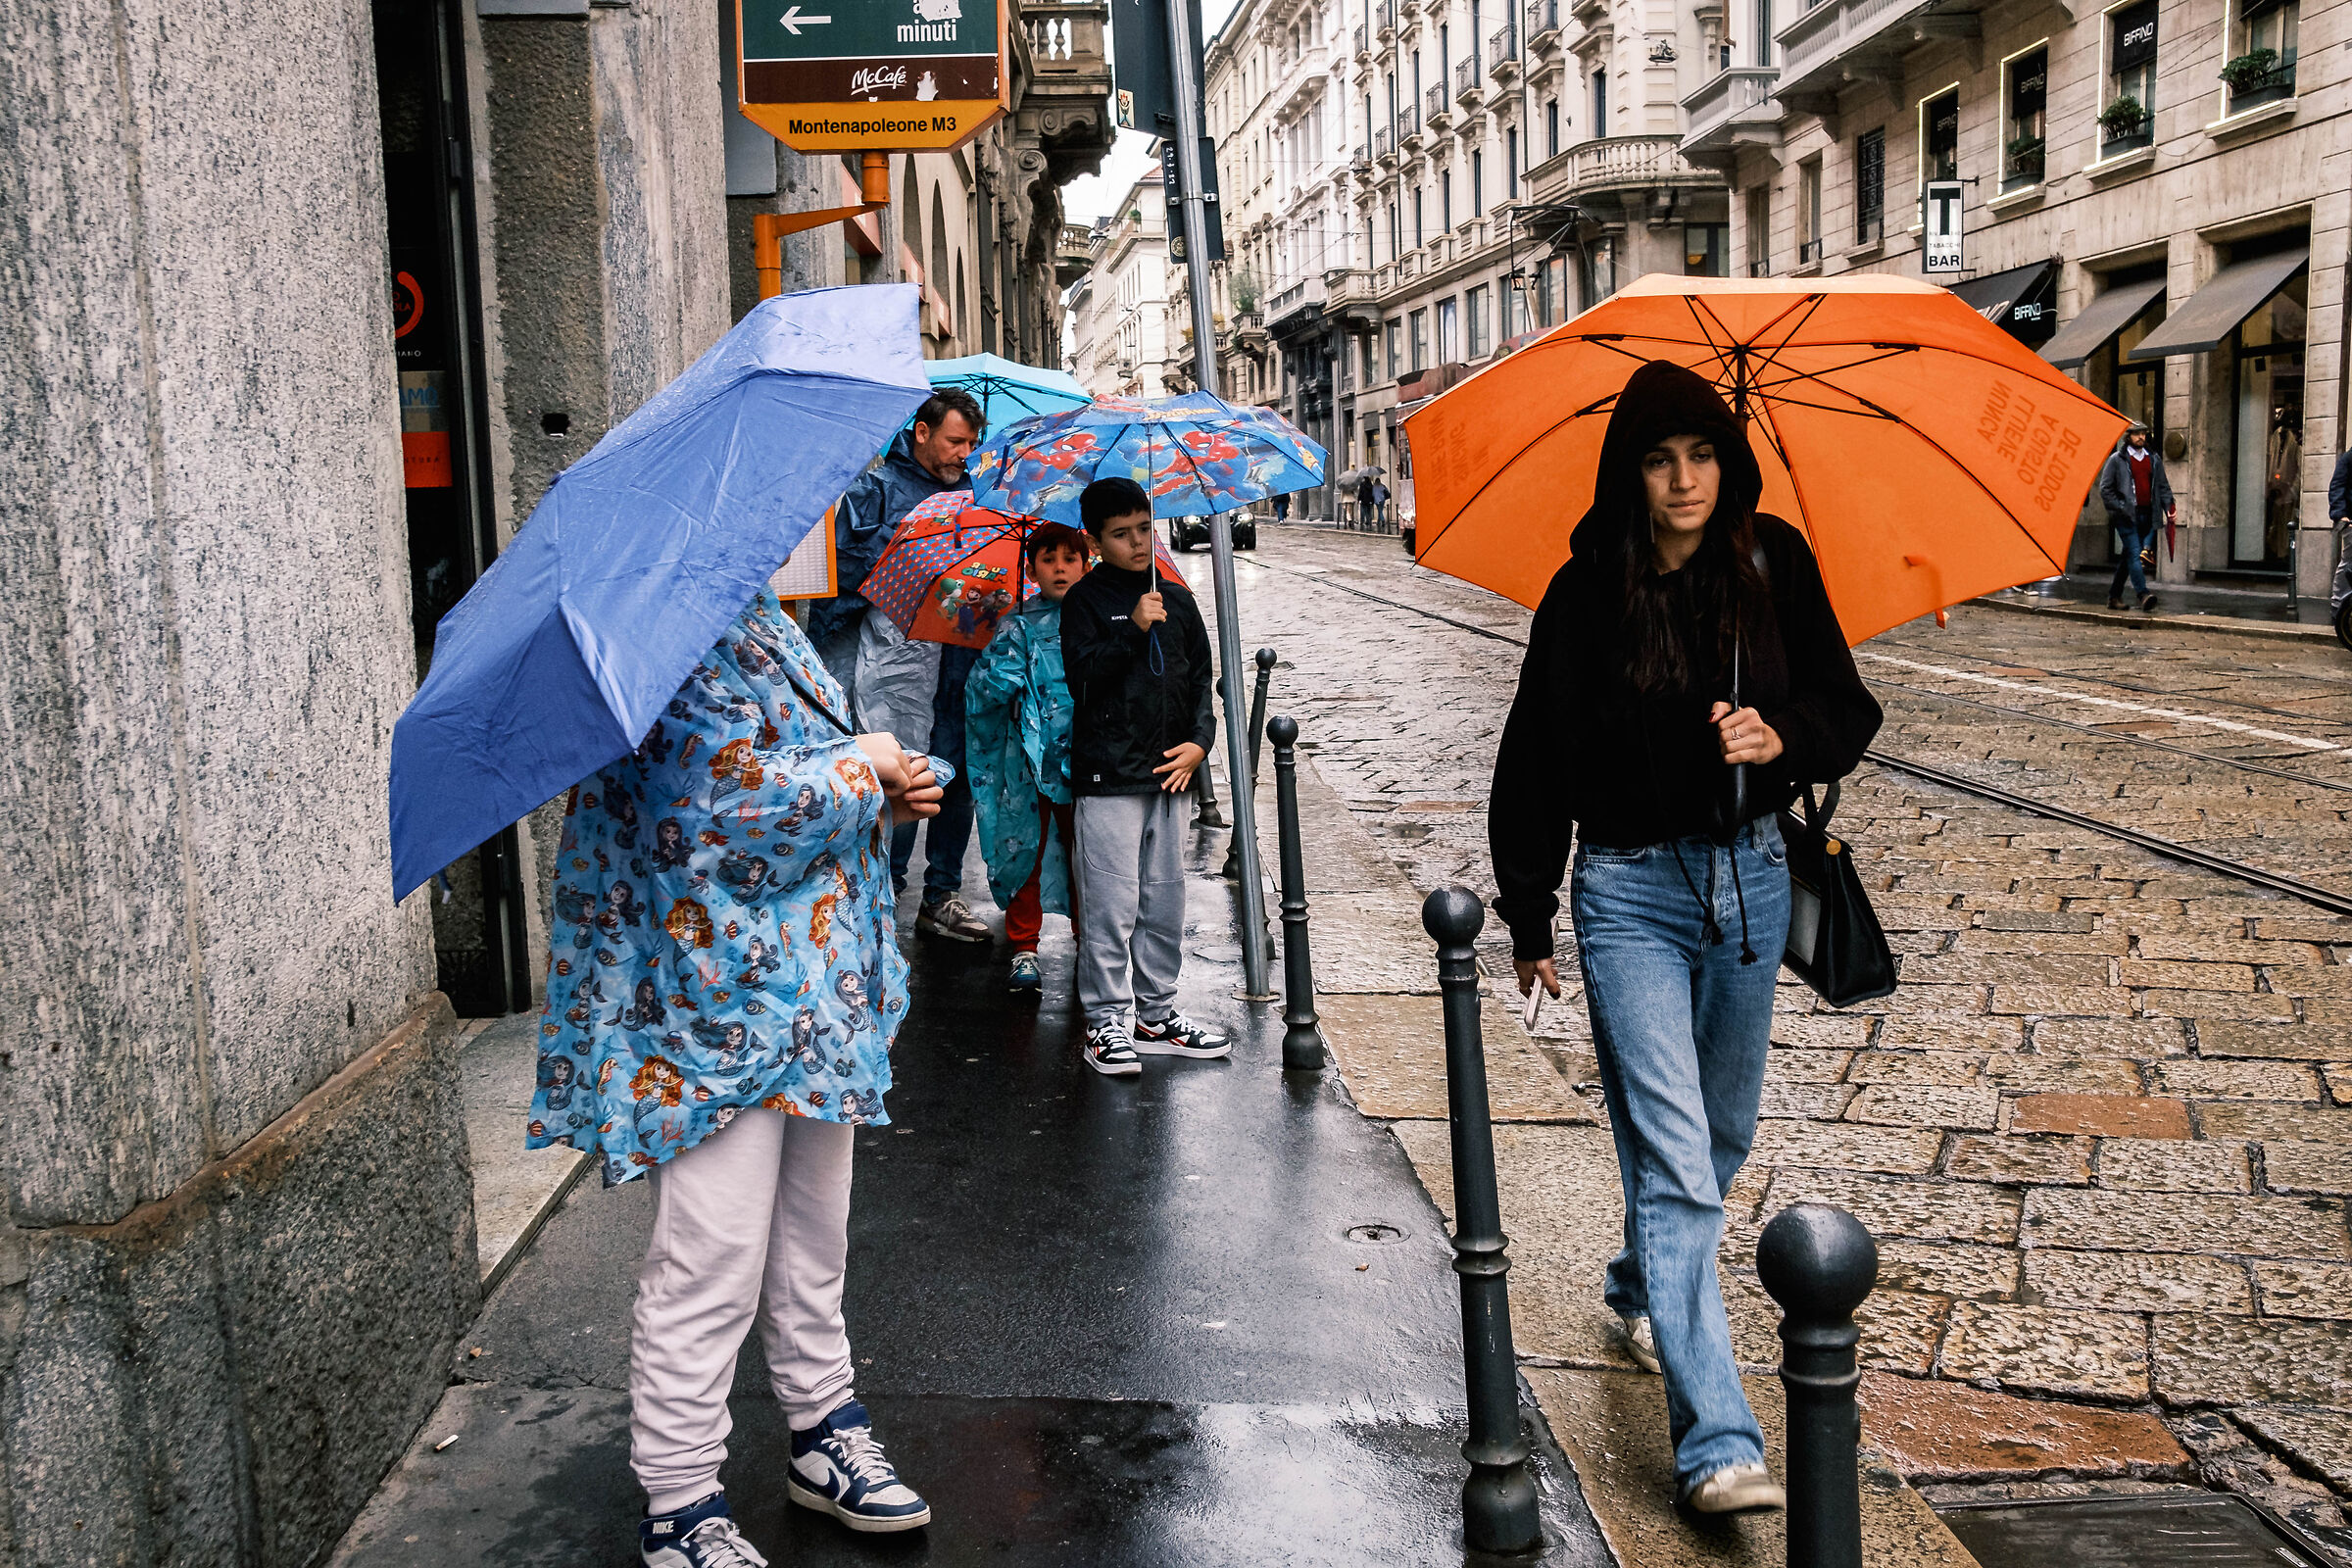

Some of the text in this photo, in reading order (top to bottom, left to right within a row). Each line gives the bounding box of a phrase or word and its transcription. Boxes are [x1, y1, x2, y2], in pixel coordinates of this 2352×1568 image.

[897, 18, 956, 42] minuti
[2124, 22, 2154, 47] BIFFINO
[851, 66, 907, 95] McCafé
[789, 117, 956, 136] Montenapoleone M3
[1930, 187, 1961, 235] T
[1929, 255, 1960, 267] BAR
[2014, 302, 2041, 320] BIFFINO
[653, 1520, 674, 1535] NIKE
